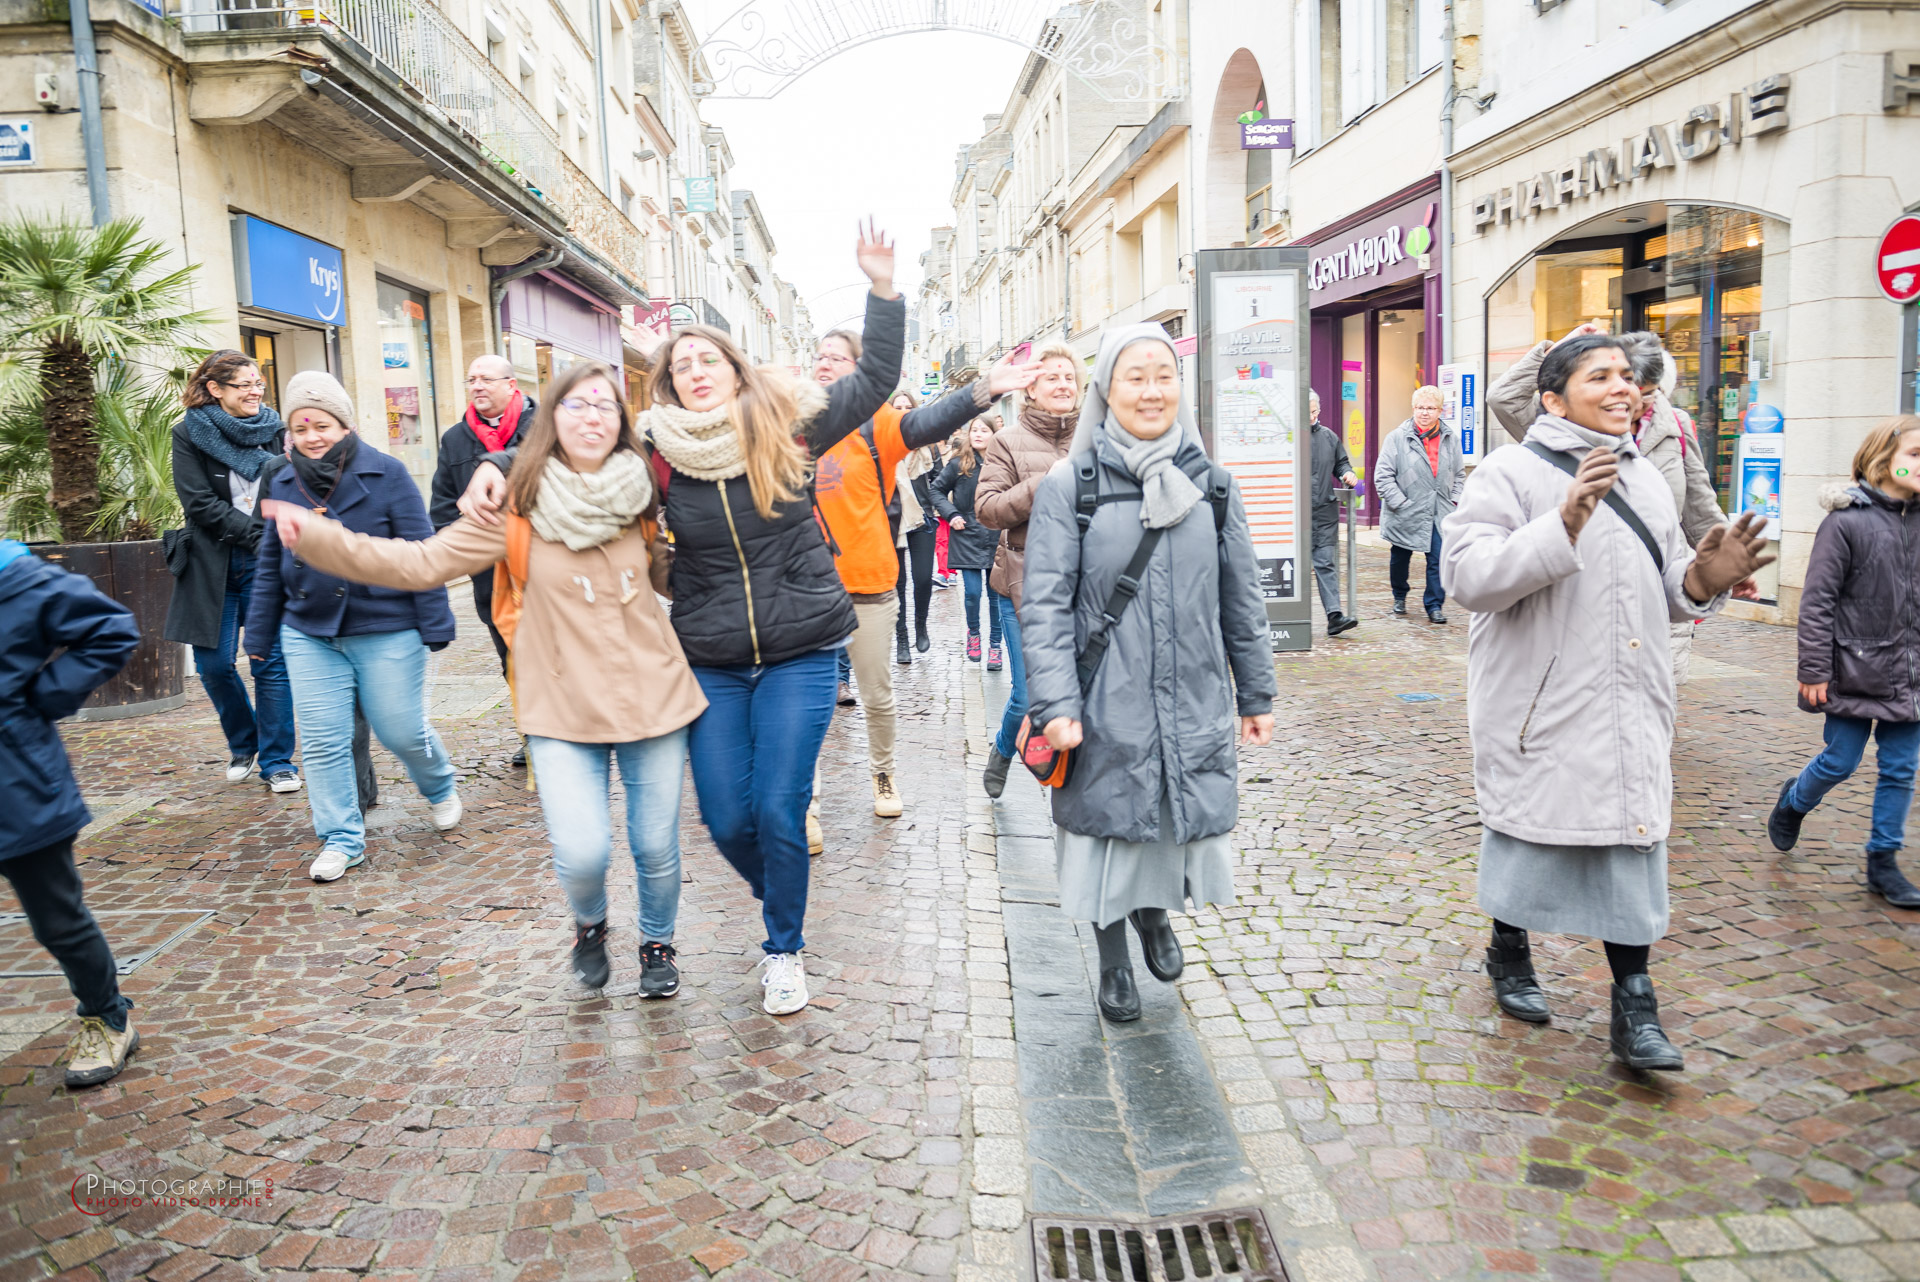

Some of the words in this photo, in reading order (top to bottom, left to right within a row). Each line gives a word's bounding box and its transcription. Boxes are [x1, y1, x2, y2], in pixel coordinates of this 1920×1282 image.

[1472, 73, 1790, 235] PHARMACIE
[309, 257, 338, 297] Krys
[1231, 332, 1251, 345] Ma
[1253, 329, 1281, 343] Ville
[1271, 630, 1290, 639] DIA
